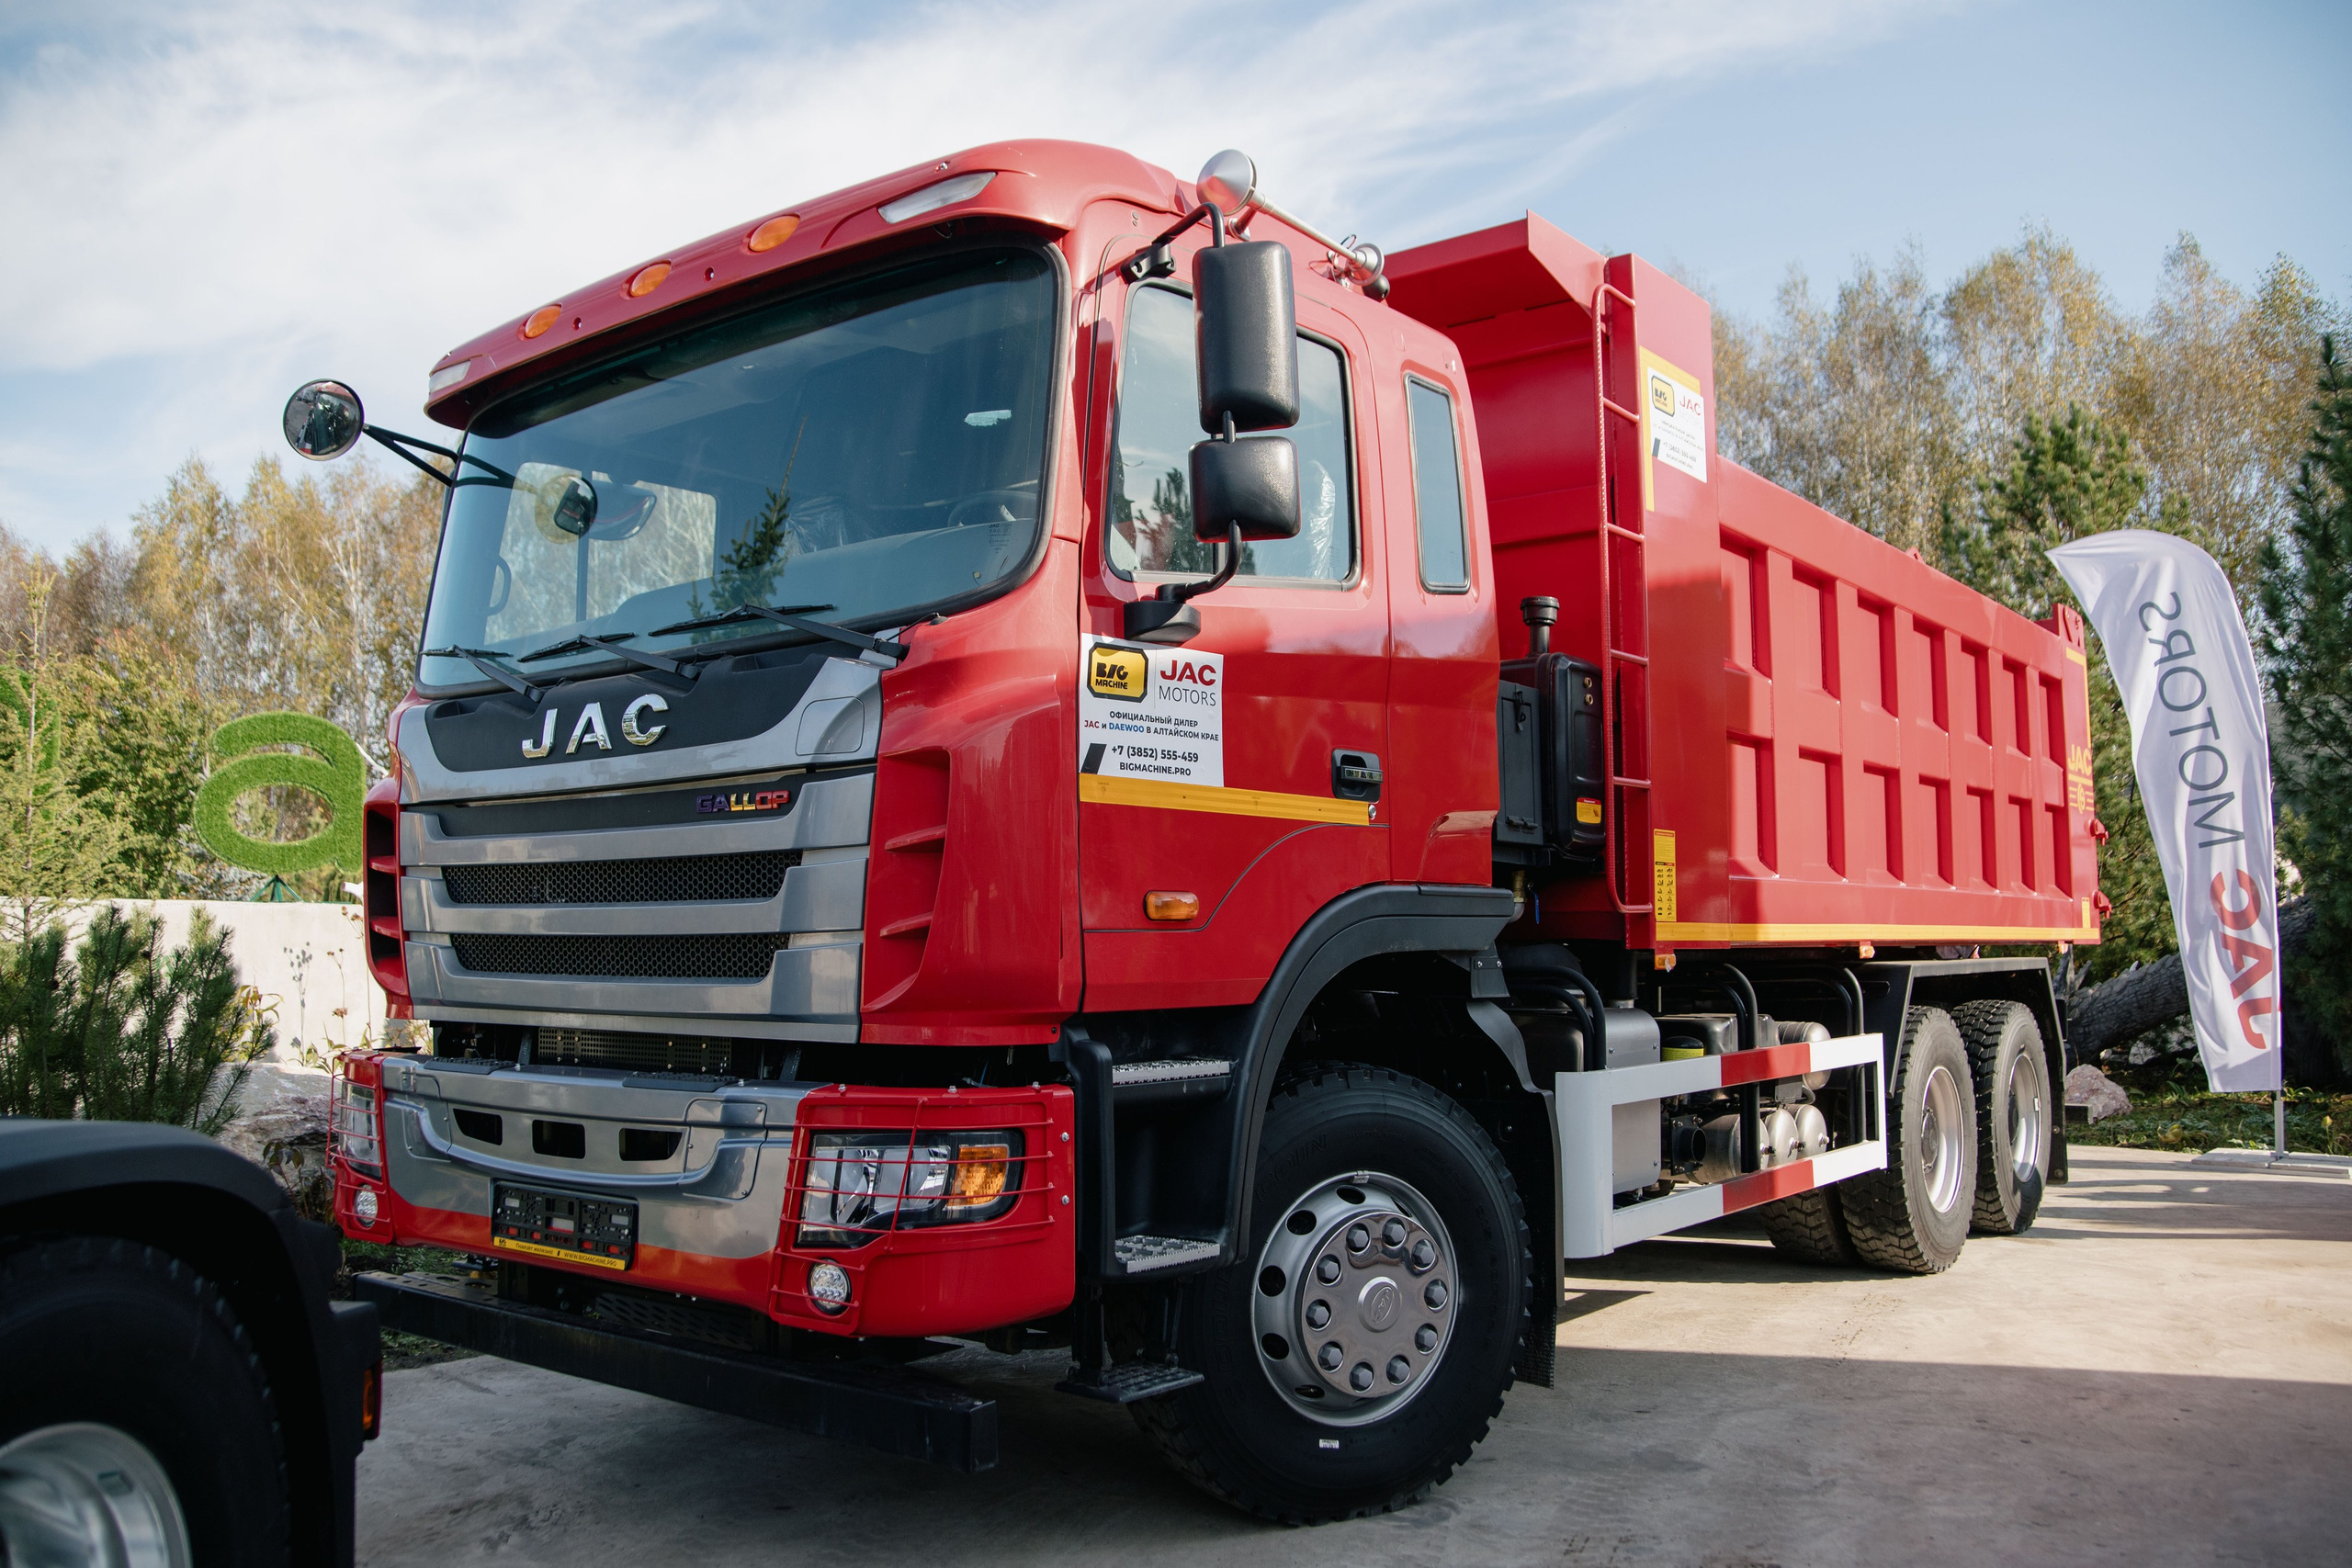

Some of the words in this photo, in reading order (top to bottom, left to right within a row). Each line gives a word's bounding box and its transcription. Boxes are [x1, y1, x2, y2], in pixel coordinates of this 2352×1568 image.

[1679, 395, 1702, 416] JAC
[1096, 661, 1129, 681] BIG
[1159, 660, 1216, 686] JAC
[1095, 679, 1128, 690] MACHINE
[1159, 685, 1216, 706] MOTORS
[521, 693, 670, 759] JAC
[1109, 710, 1172, 725] ОФИЦИАЛЬНЫЙ
[1173, 716, 1199, 728] ДИЛЕР
[1084, 720, 1100, 729] JAC
[1109, 722, 1145, 733] DAEWOO
[1146, 726, 1151, 734] В
[1153, 726, 1200, 739] АЛТАЙСКОМ
[1201, 731, 1219, 741] КРАЕ
[1112, 745, 1125, 756] +7
[1126, 745, 1158, 761] (3852)
[1160, 749, 1199, 762] 555-459
[2068, 743, 2092, 776] JAC
[1119, 761, 1192, 776] BIGMACHINE.PRO
[695, 790, 791, 814] GALLOP
